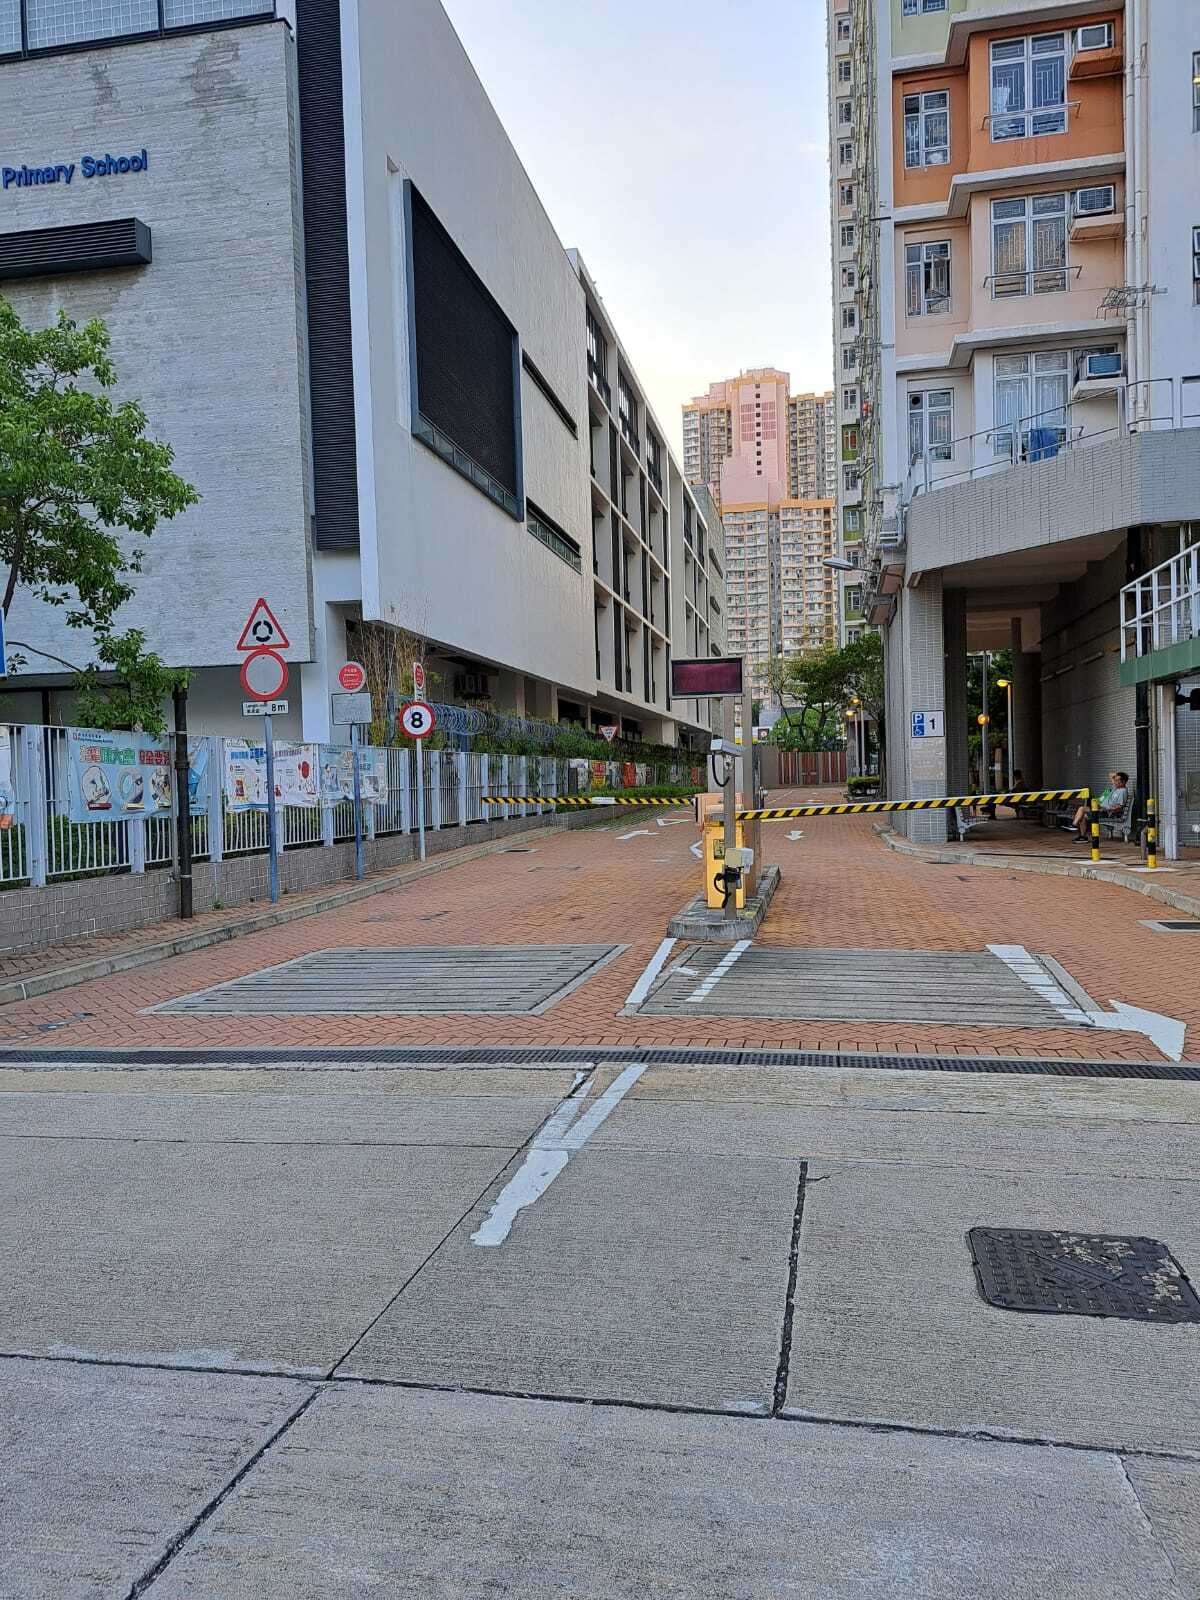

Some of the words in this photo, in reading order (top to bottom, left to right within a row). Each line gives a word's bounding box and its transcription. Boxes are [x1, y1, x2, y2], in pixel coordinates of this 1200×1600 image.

[2, 164, 75, 189] Primary
[81, 149, 148, 178] School
[411, 711, 424, 729] 8
[914, 713, 923, 724] P
[929, 718, 936, 730] 1
